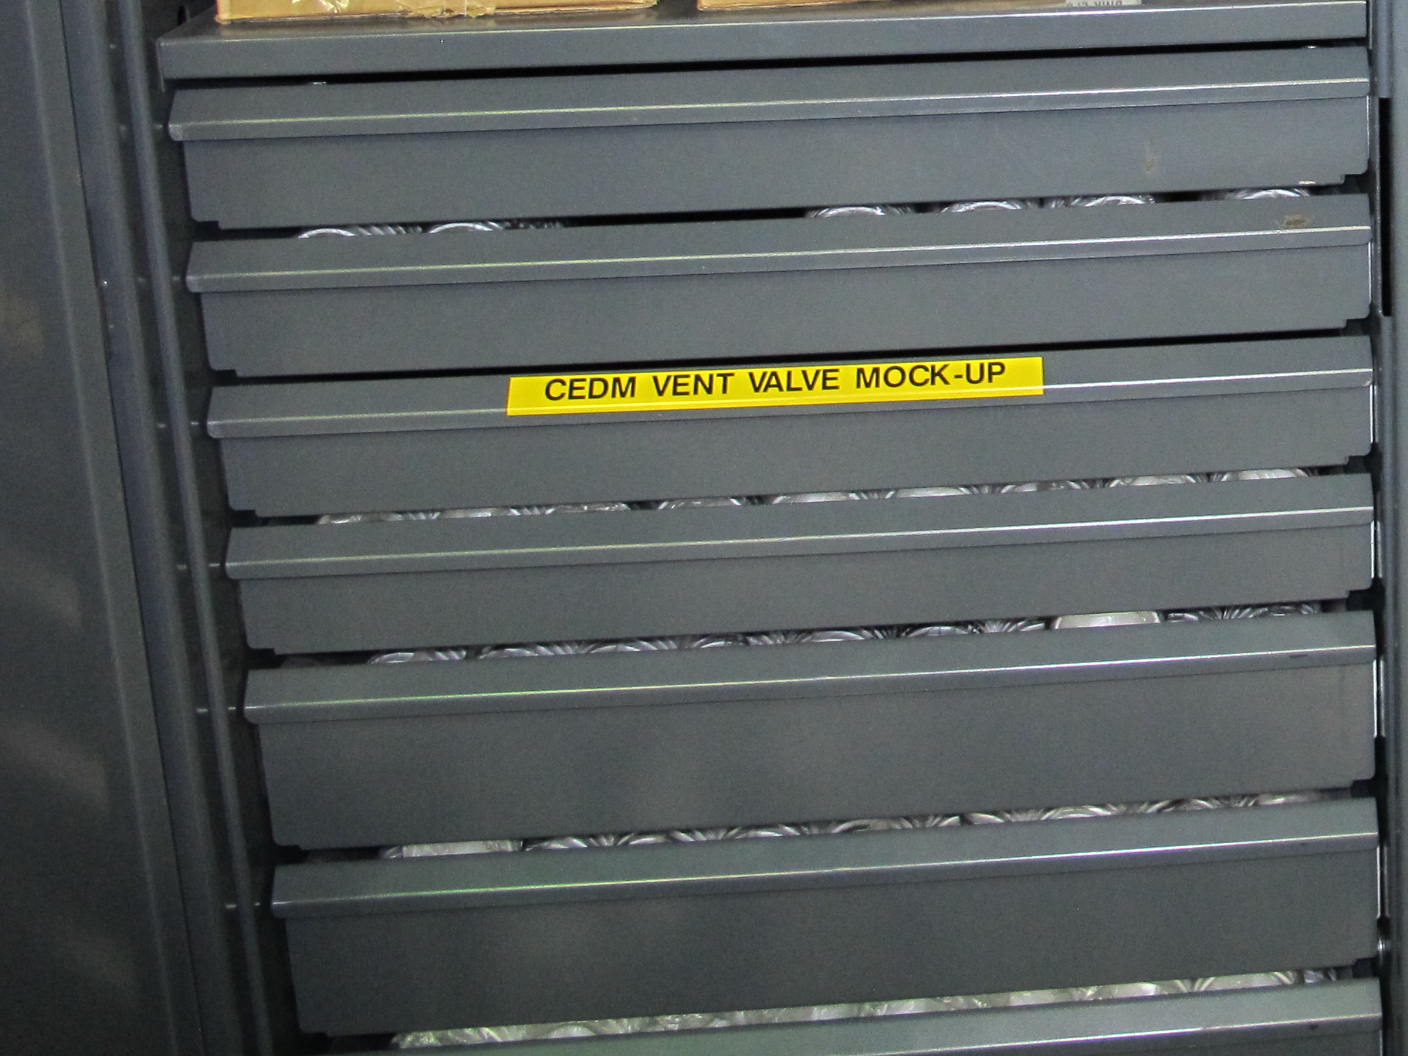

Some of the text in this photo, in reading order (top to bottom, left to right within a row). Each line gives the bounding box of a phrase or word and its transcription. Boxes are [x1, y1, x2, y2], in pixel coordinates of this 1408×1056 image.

[545, 361, 1006, 401] CEDM VENT VALVE MOCK-UP
